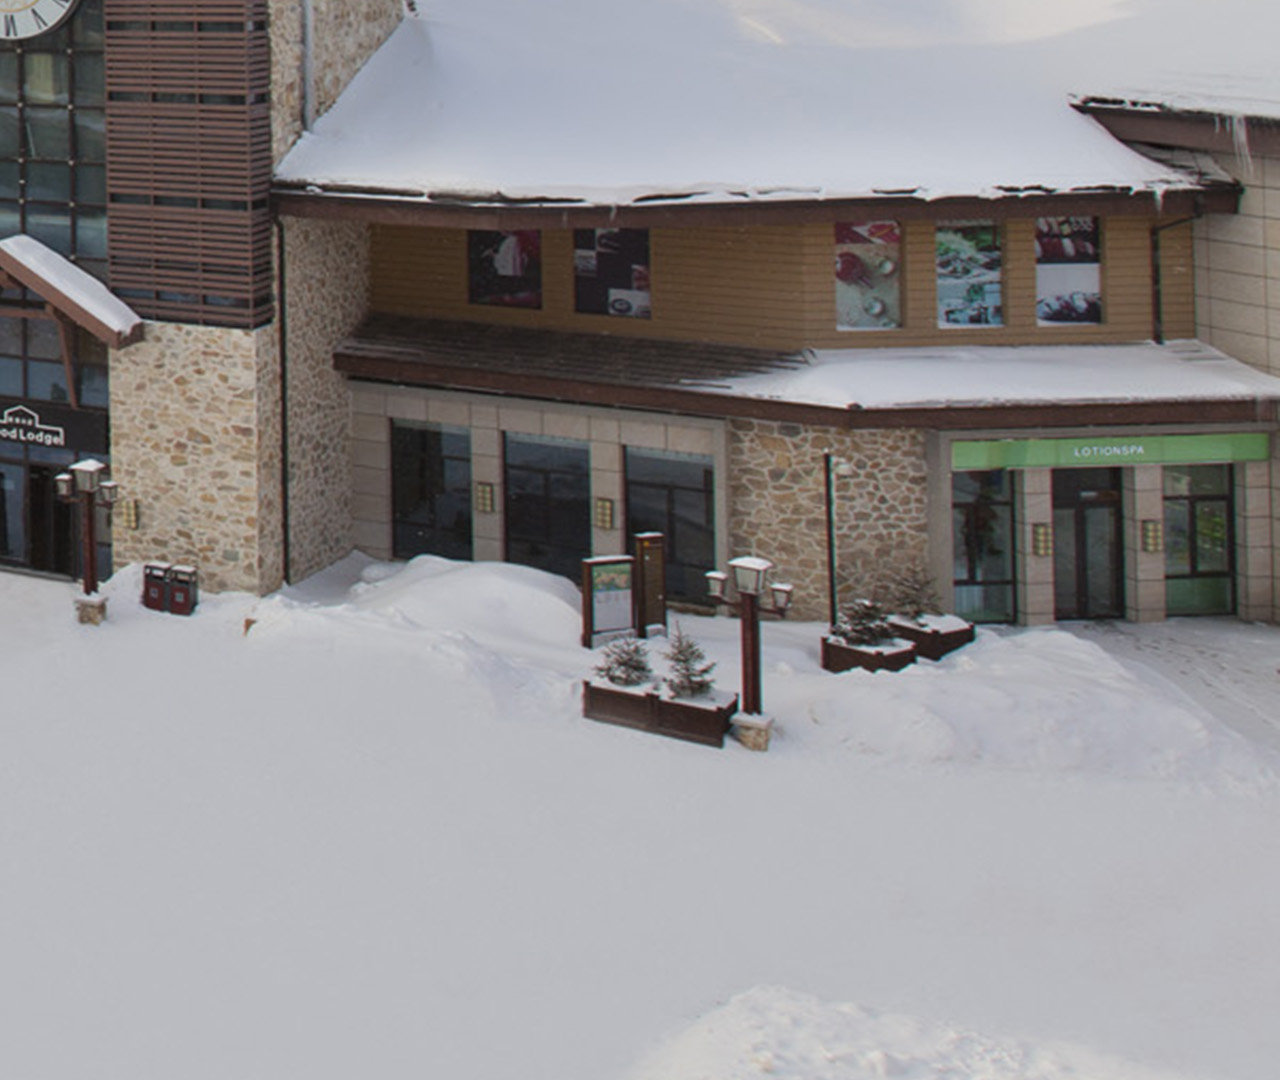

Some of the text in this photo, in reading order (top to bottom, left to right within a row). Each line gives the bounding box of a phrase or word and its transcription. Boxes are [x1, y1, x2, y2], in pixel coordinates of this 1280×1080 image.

[4, 14, 18, 37] VI
[31, 8, 48, 30] V
[19, 429, 60, 445] Lodge
[1074, 445, 1144, 457] LOTIONSPA
